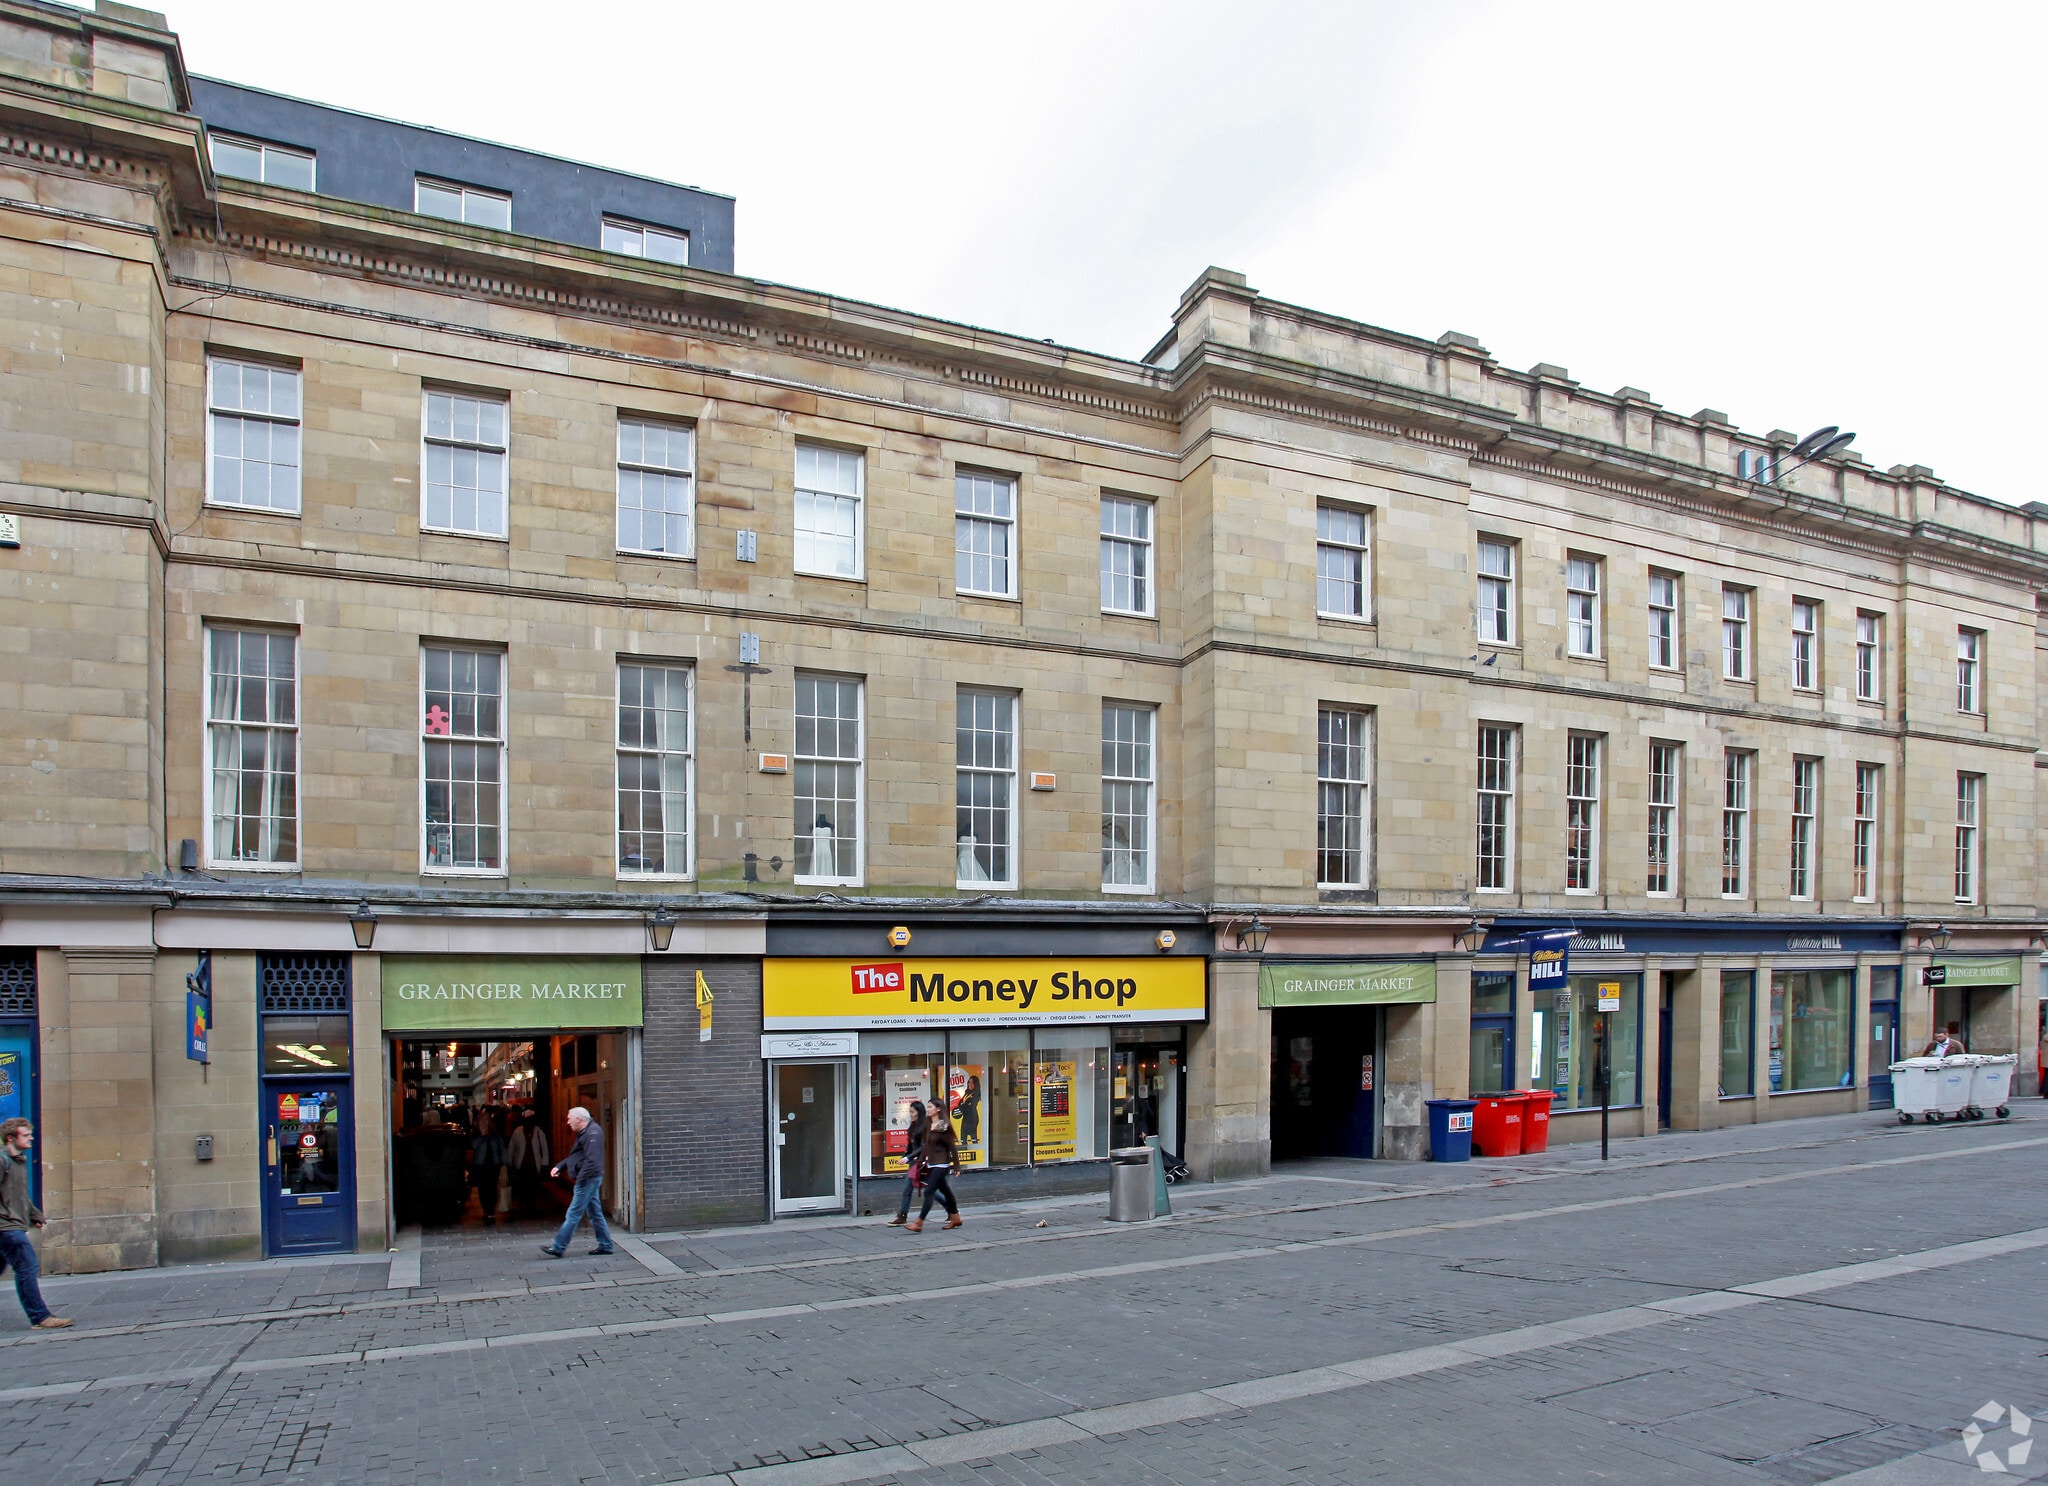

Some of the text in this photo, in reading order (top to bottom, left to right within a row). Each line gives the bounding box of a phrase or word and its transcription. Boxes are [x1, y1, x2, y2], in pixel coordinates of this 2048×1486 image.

[1600, 933, 1625, 950] HILL
[1821, 934, 1842, 949] HILL
[1531, 961, 1563, 979] HILL
[1946, 967, 2010, 978] RAINGER MARKET
[398, 983, 627, 1000] GRAINGER MARKET
[854, 967, 1137, 1009] The Money Shop
[1284, 977, 1414, 993] GRAINGER MARKET
[193, 1040, 207, 1052] CORAL
[280, 1124, 321, 1134] CORAL
[304, 1136, 314, 1145] 18
